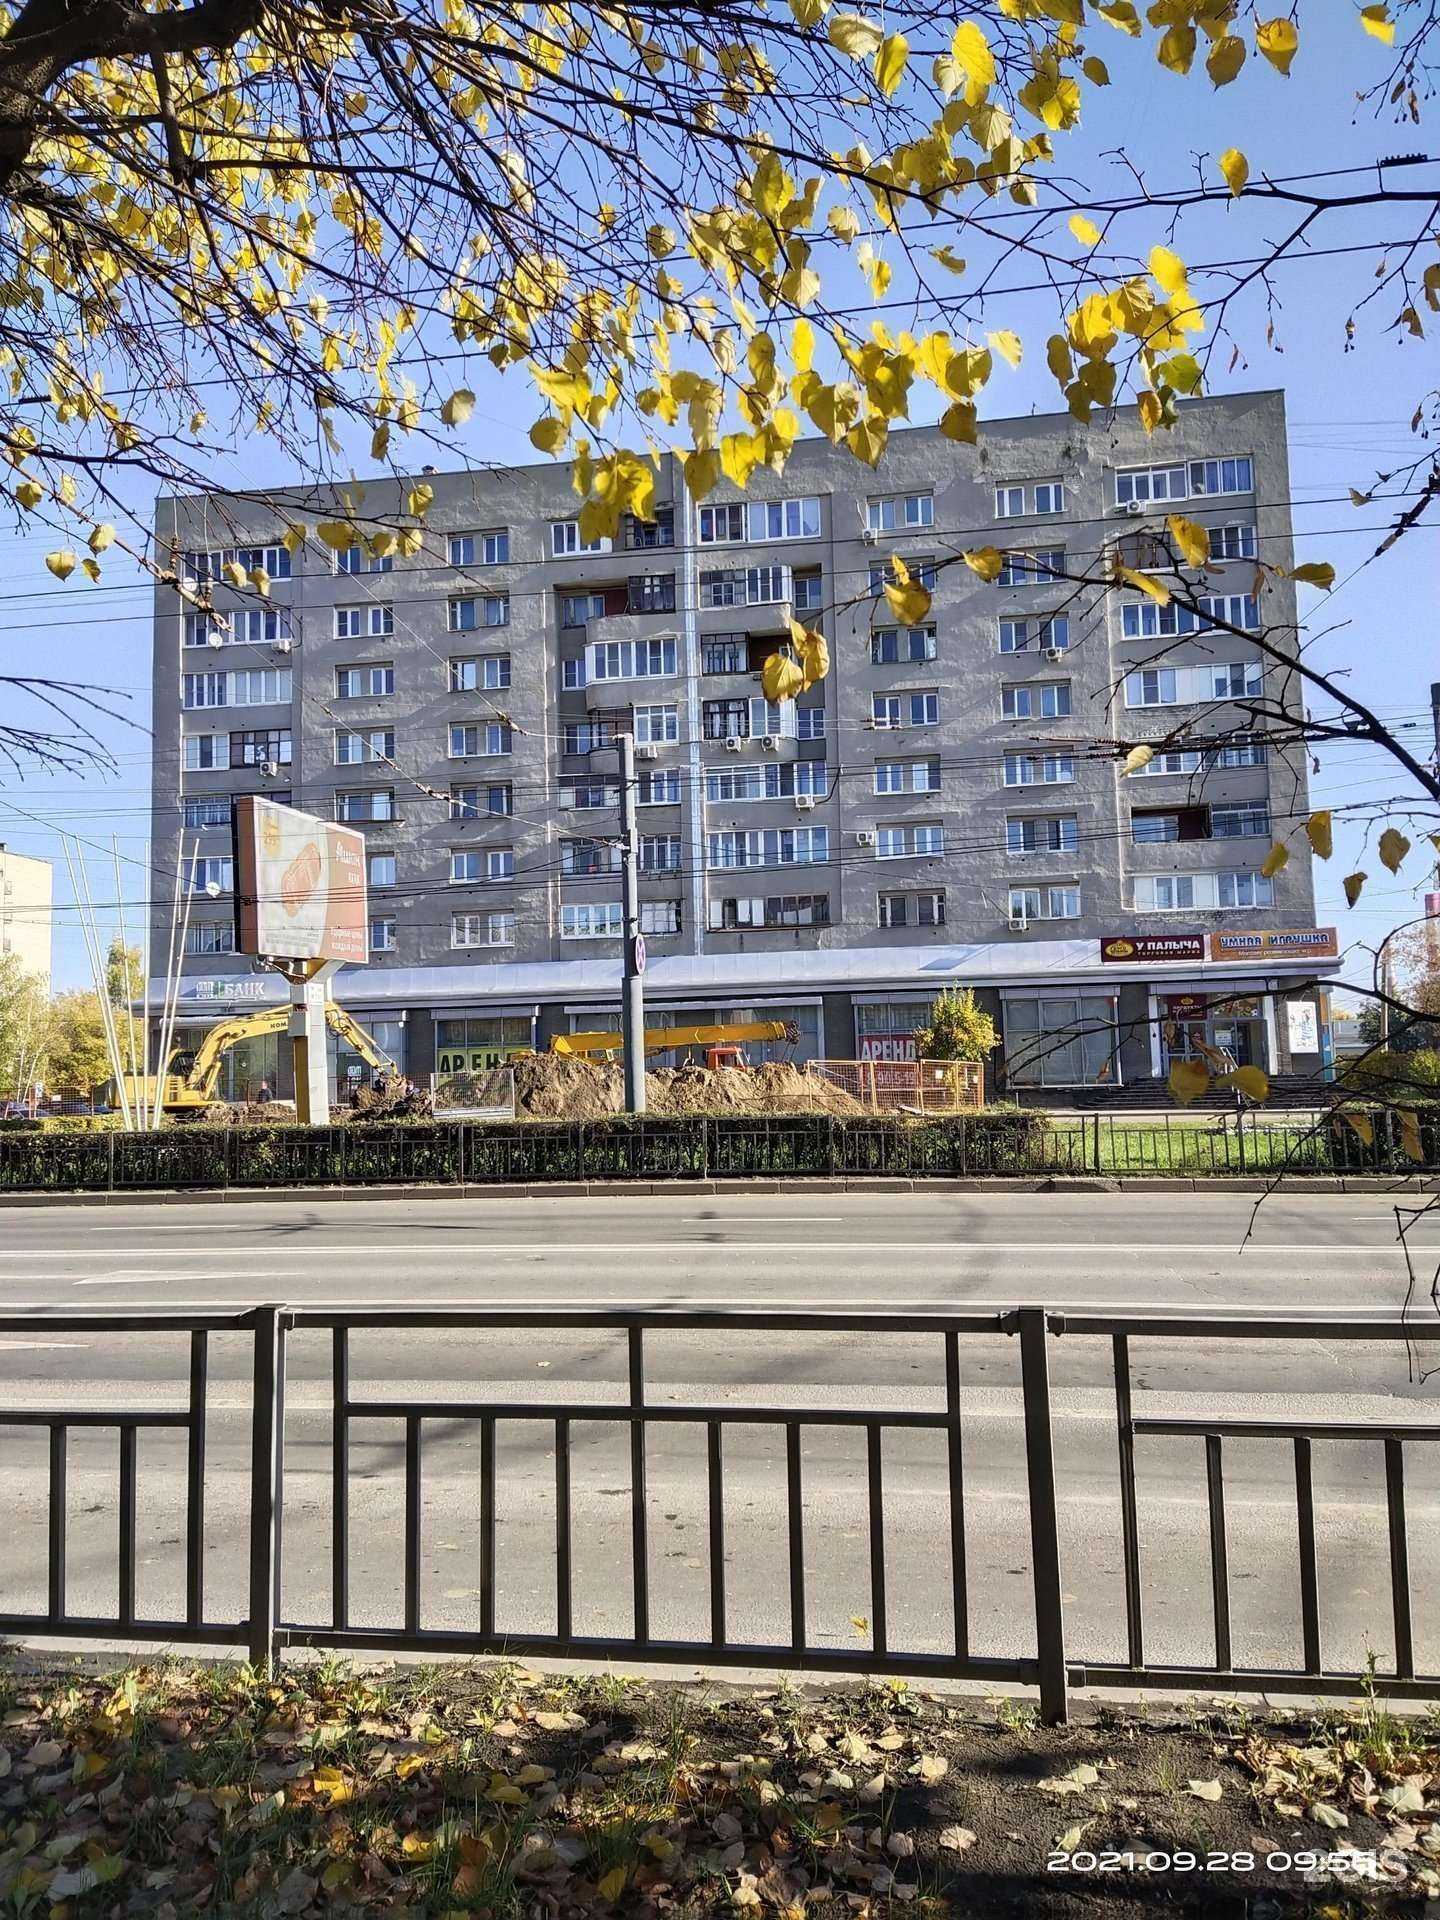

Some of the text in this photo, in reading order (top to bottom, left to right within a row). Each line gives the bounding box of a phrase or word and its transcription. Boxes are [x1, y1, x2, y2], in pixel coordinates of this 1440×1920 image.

[1136, 942, 1145, 951] У
[1147, 940, 1201, 950] ПАЛЫЧА
[1221, 933, 1330, 947] УМНАЯ ИГРУШКА
[224, 982, 265, 997] БАНК
[440, 1053, 513, 1073] АРЕН
